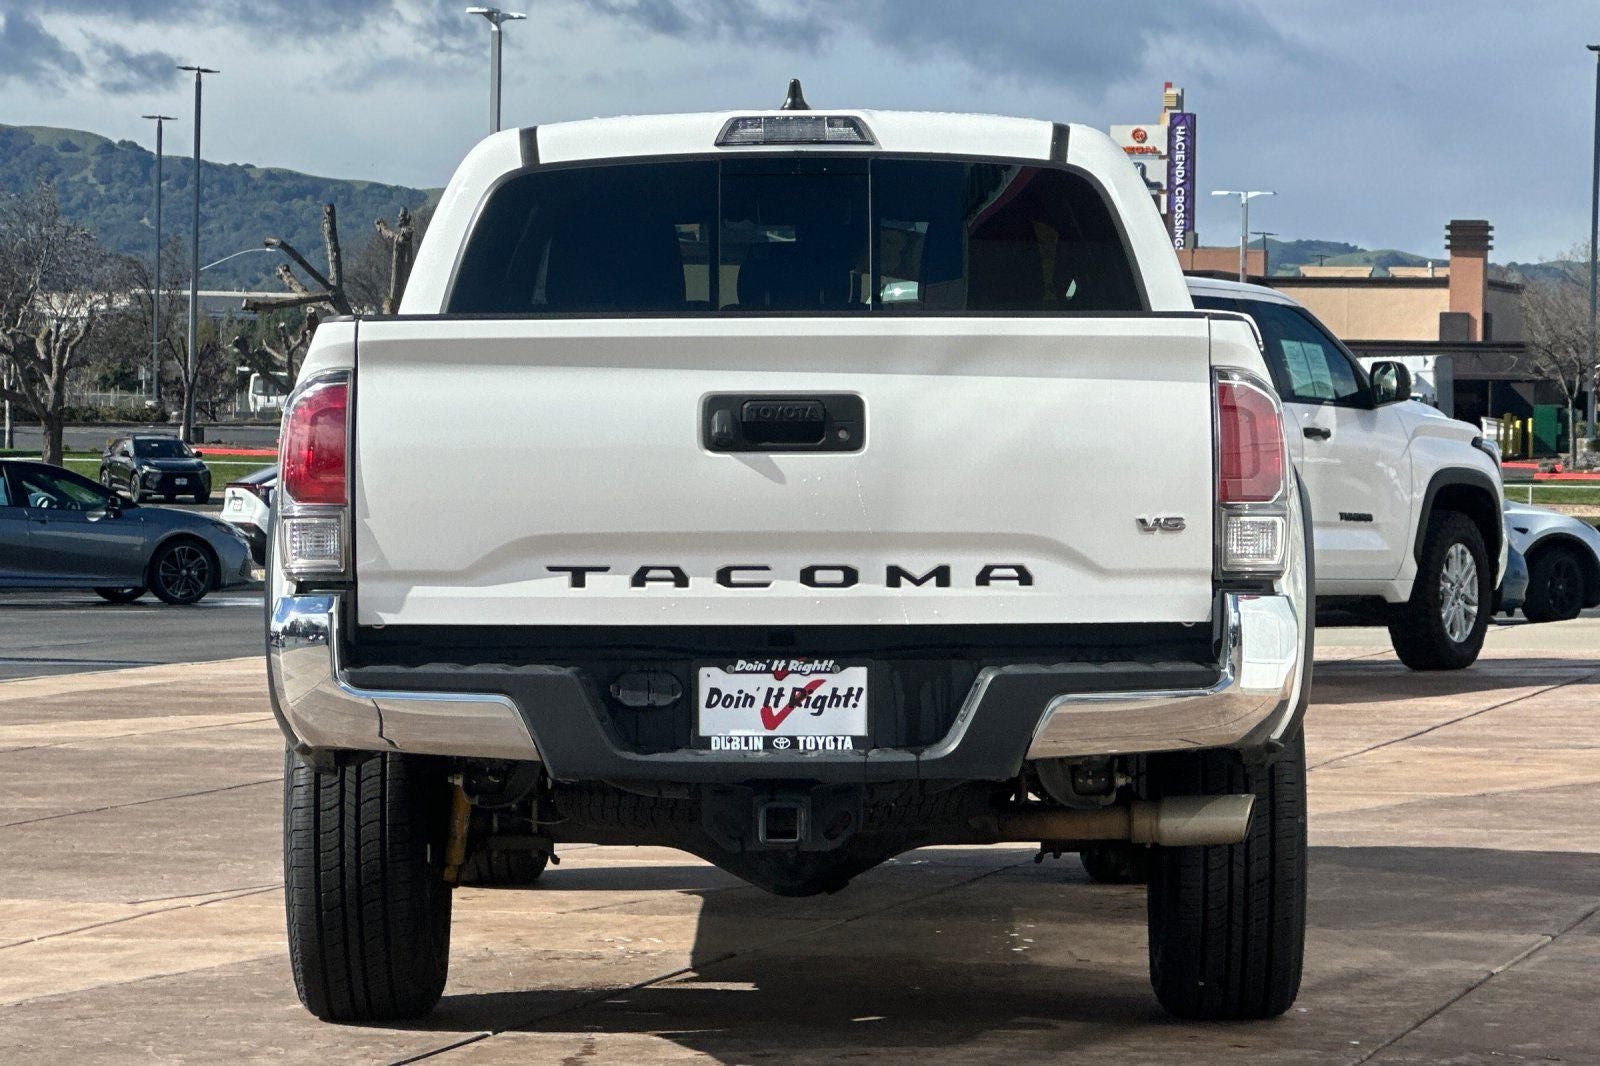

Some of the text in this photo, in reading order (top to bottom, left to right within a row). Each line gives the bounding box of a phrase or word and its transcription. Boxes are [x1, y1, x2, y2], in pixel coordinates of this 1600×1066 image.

[1175, 126, 1185, 185] HACIENDA
[751, 405, 818, 419] TOYOTA
[1136, 516, 1186, 534] V6
[546, 564, 1035, 589] TACOMA
[735, 659, 835, 676] Doin' It Right!
[705, 686, 864, 716] Doin' It Right!
[711, 736, 853, 750] DUBLIN TOYOTA
